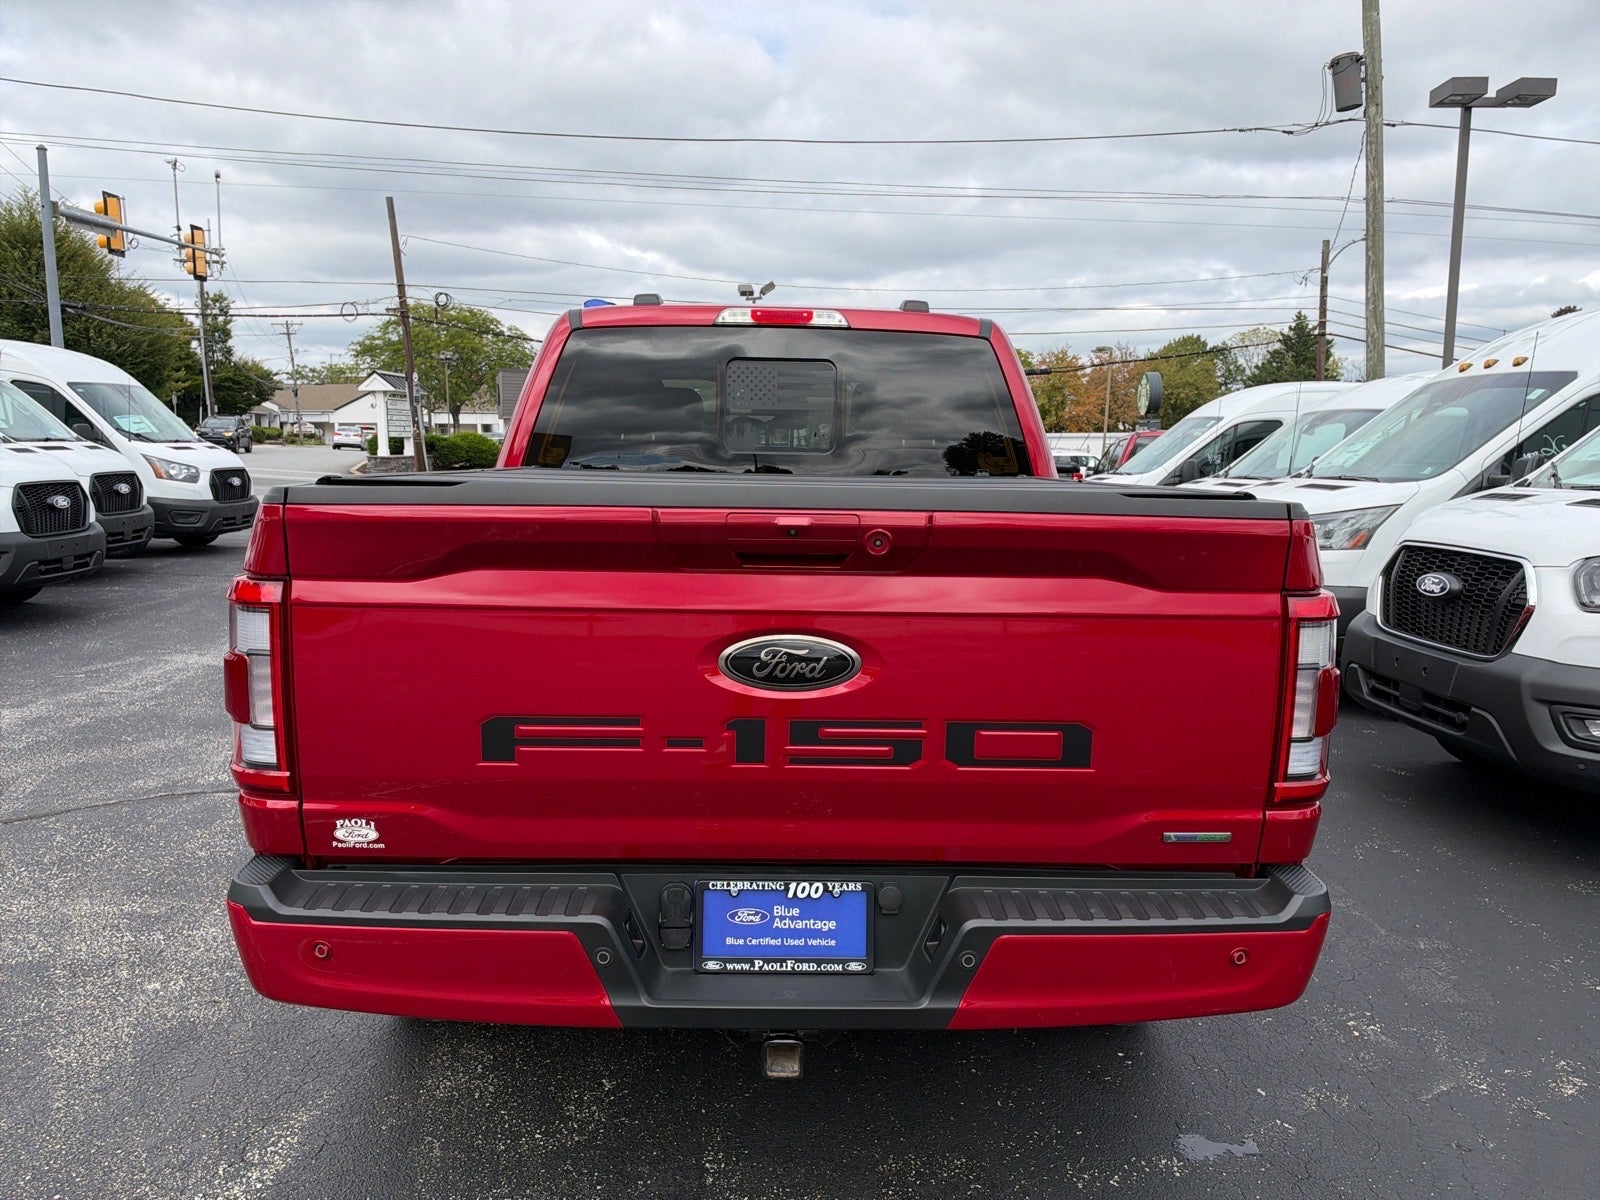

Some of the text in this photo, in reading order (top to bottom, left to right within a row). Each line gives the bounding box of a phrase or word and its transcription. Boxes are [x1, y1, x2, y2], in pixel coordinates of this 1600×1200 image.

[1420, 576, 1444, 593] Ford
[752, 646, 828, 679] Ford
[478, 715, 1094, 772] F-150
[335, 818, 375, 829] PAOLI
[342, 829, 370, 839] Ford
[332, 841, 385, 849] PaoliFord.com
[708, 881, 862, 899] CELEBRATING 100 YEARS
[734, 910, 762, 922] Ford
[773, 905, 800, 917] Blue
[772, 918, 837, 931] Advantage
[725, 936, 836, 946] Blue Certified Used Vehicle
